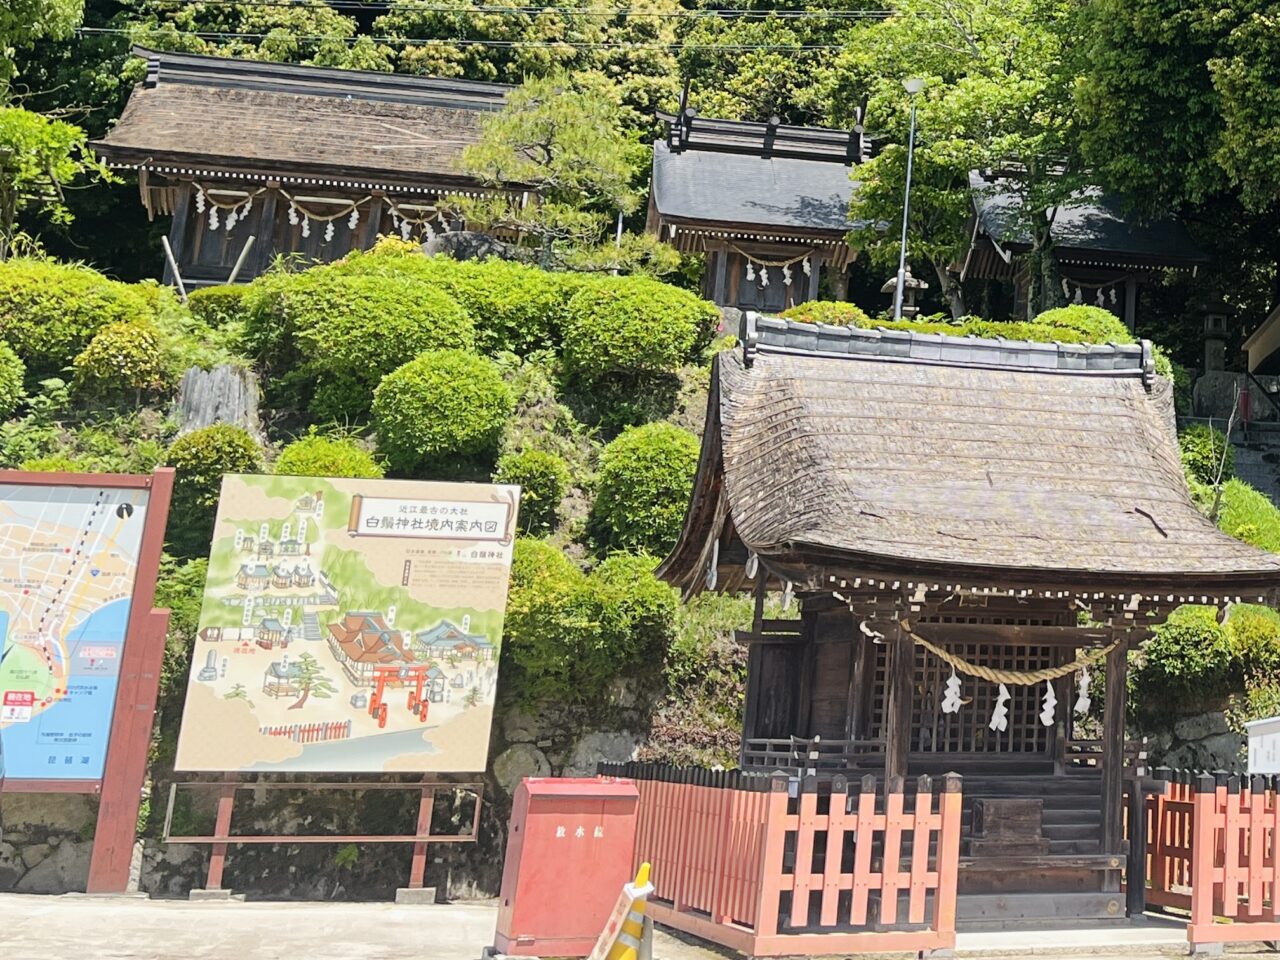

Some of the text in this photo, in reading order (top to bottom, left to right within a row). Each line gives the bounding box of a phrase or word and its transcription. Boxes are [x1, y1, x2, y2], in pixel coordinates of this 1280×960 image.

[400, 505, 468, 515] 近江最古の大社
